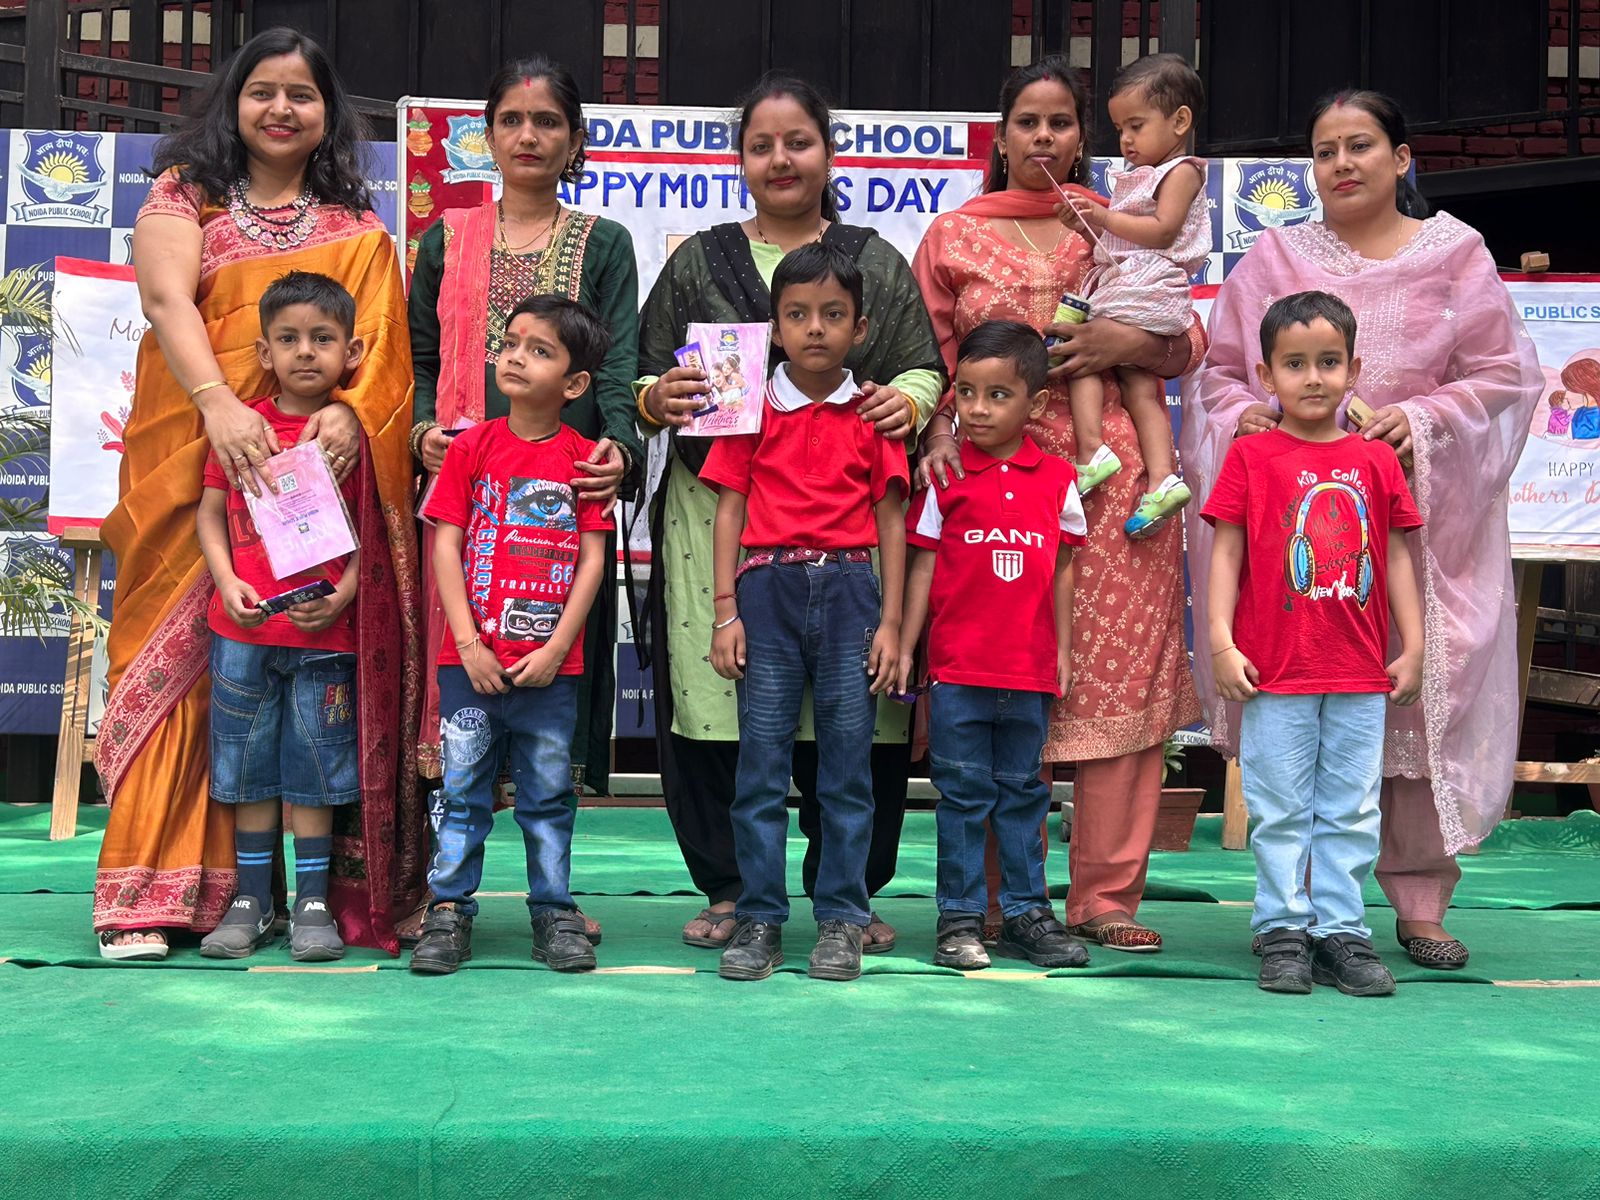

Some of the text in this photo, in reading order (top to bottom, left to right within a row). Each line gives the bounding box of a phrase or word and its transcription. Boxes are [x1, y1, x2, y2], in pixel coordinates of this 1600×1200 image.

[831, 122, 964, 155] CHOOL
[118, 173, 145, 184] NOIDA
[867, 177, 949, 213] DAY
[28, 207, 92, 220] NOIDA PUBLIC SCHOOL
[37, 271, 55, 281] PUB
[1524, 306, 1587, 319] PUBLIC
[1548, 461, 1594, 477] HAPPY
[28, 474, 50, 486] PUBL
[1511, 481, 1568, 504] others
[964, 528, 1045, 548] GANT
[475, 527, 497, 604] ENJOY
[550, 562, 574, 584] 66
[500, 579, 569, 594] TRAVELL
[52, 617, 70, 628] SCHOO
[0, 682, 14, 694] IDA
[17, 682, 48, 694] PUBLIC
[231, 899, 251, 909] AIR
[304, 901, 326, 911] AIR
